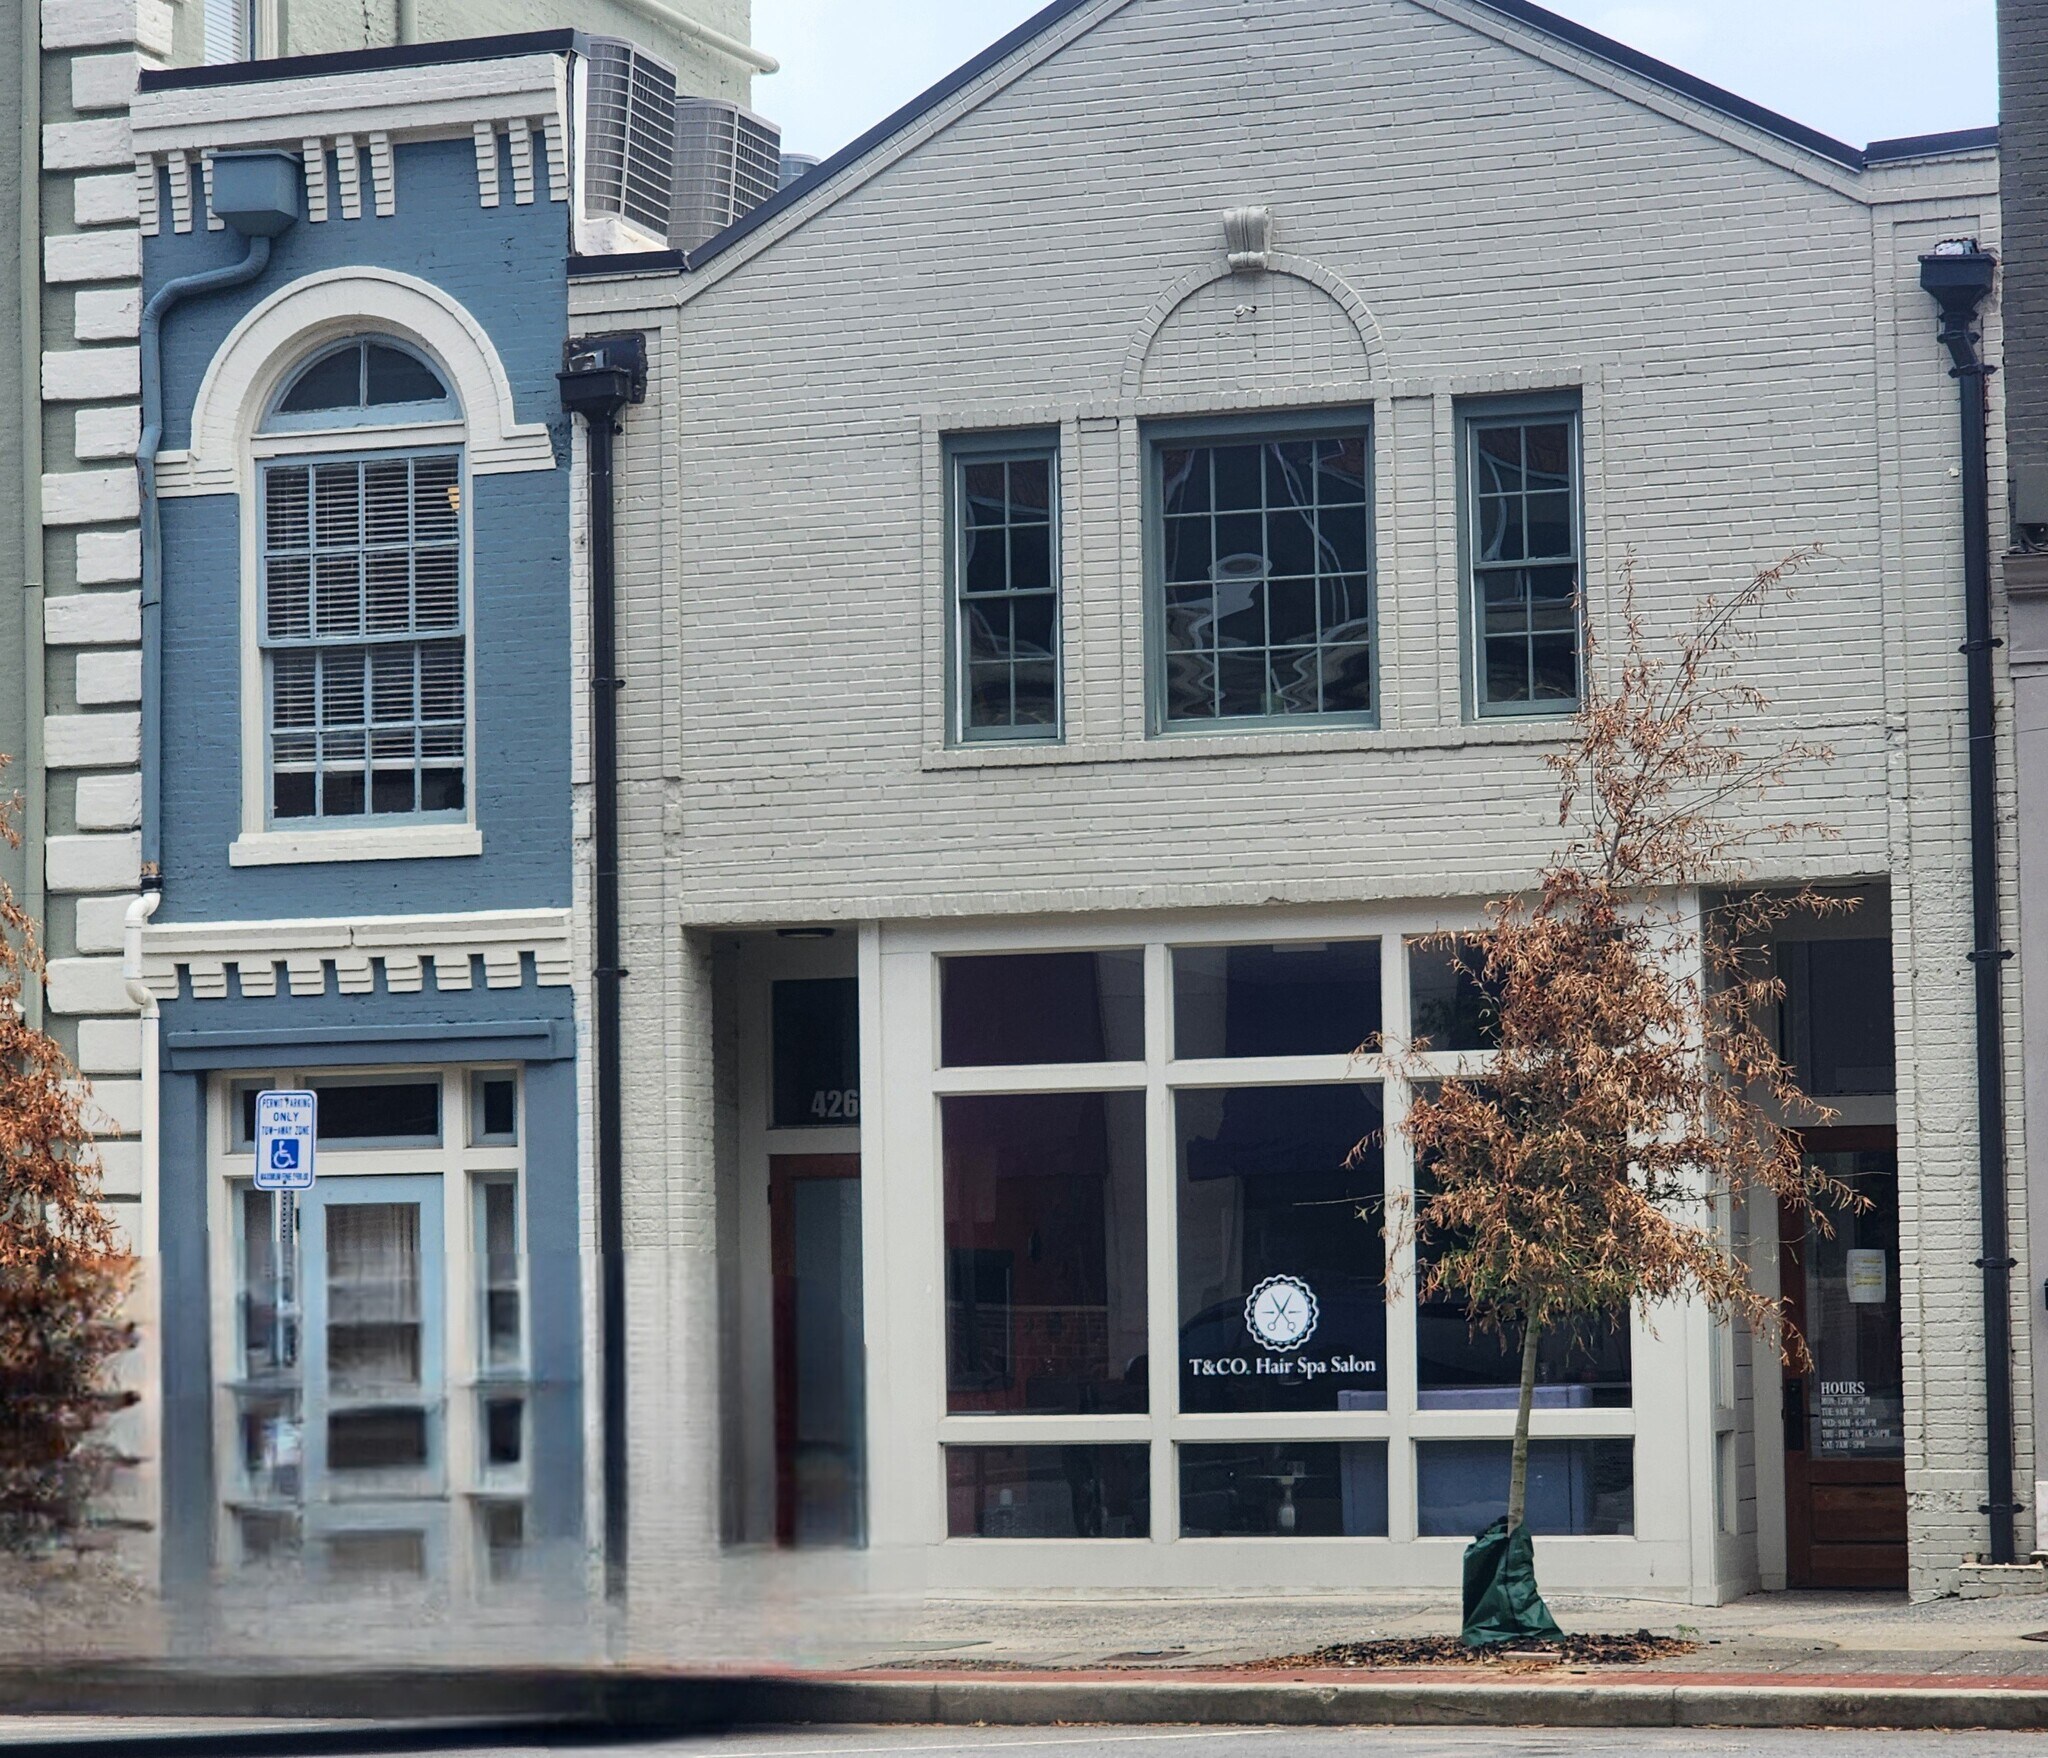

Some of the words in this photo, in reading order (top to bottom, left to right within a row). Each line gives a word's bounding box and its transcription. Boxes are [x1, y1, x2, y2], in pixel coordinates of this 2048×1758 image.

[262, 1098, 283, 1108] PERMIT
[285, 1098, 311, 1108] PARKING
[811, 1089, 858, 1117] 426
[273, 1112, 299, 1122] ONLY
[262, 1126, 292, 1135] TOW-AWAY
[295, 1126, 309, 1135] ZONE
[1189, 1358, 1251, 1375] T&CO.
[1256, 1358, 1294, 1375] Hair
[1298, 1356, 1326, 1379] Spa
[1331, 1354, 1376, 1373] Salon
[1821, 1381, 1865, 1394] HOURS
